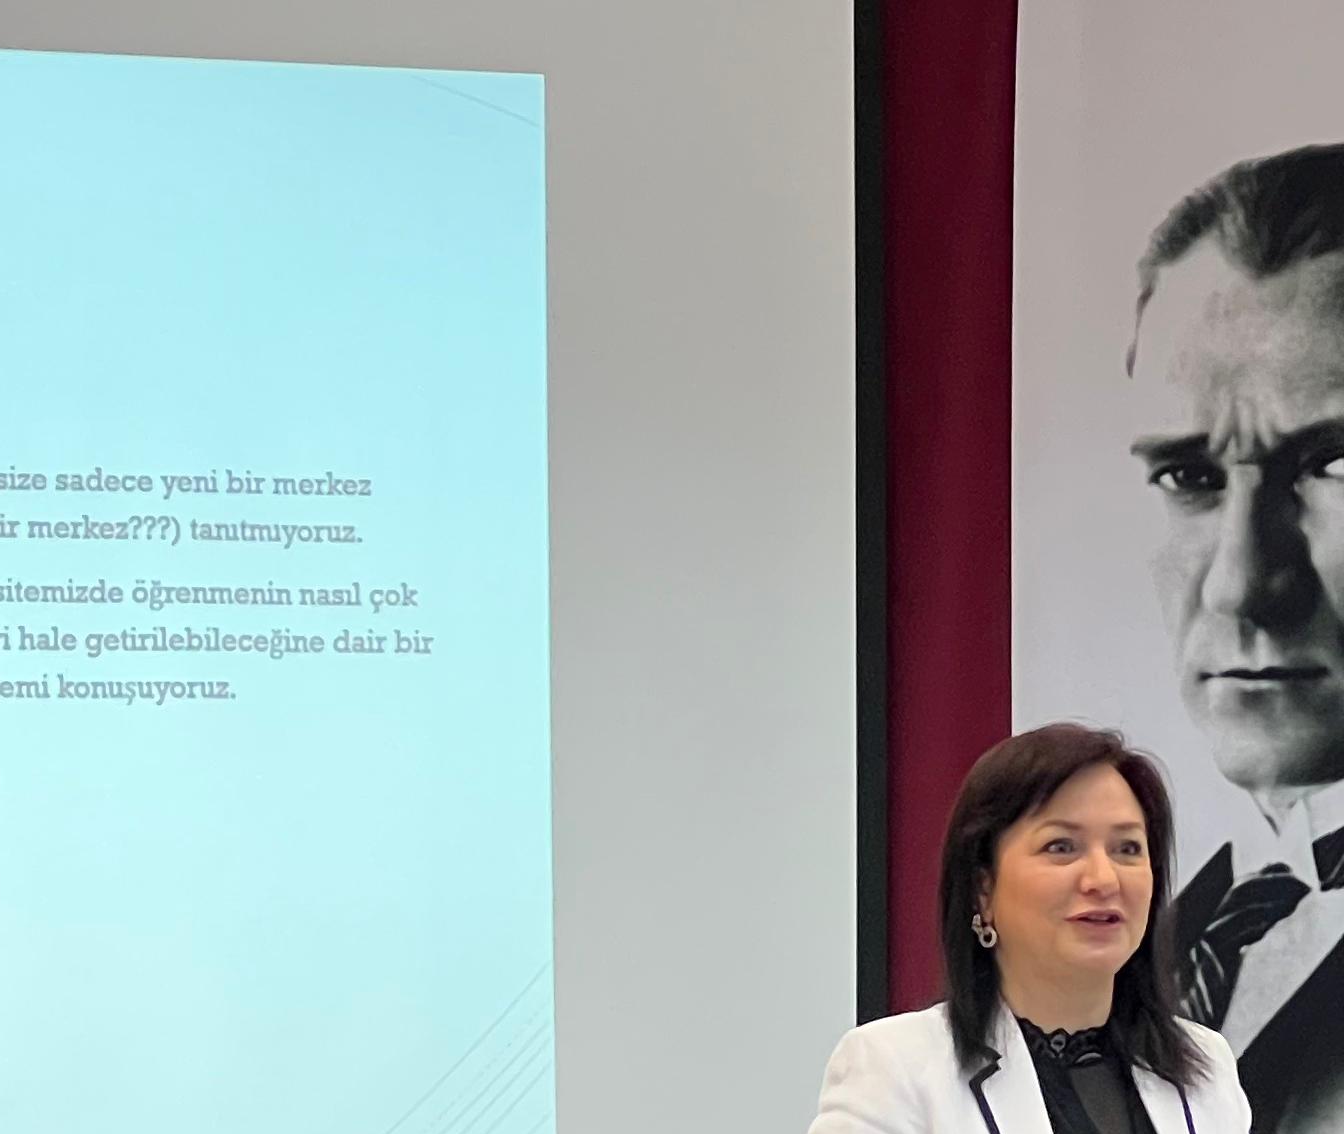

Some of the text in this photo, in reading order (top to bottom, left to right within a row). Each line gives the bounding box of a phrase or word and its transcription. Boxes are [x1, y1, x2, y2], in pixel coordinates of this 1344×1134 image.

[55, 466, 154, 493] sadece
[160, 469, 219, 500] yeni
[225, 469, 265, 495] bir
[272, 471, 372, 496] merkez
[27, 514, 181, 546] merkez???)
[190, 518, 363, 549] tanıtmıyoruz.
[131, 579, 293, 611] öğrenmenin
[298, 582, 362, 606] nasıl
[369, 582, 418, 614] çok
[17, 626, 77, 651] hale
[84, 626, 325, 660] getirilebileceğine
[332, 628, 387, 654] dair
[393, 629, 435, 654] bir
[57, 673, 237, 706] konuşuyoruz.
